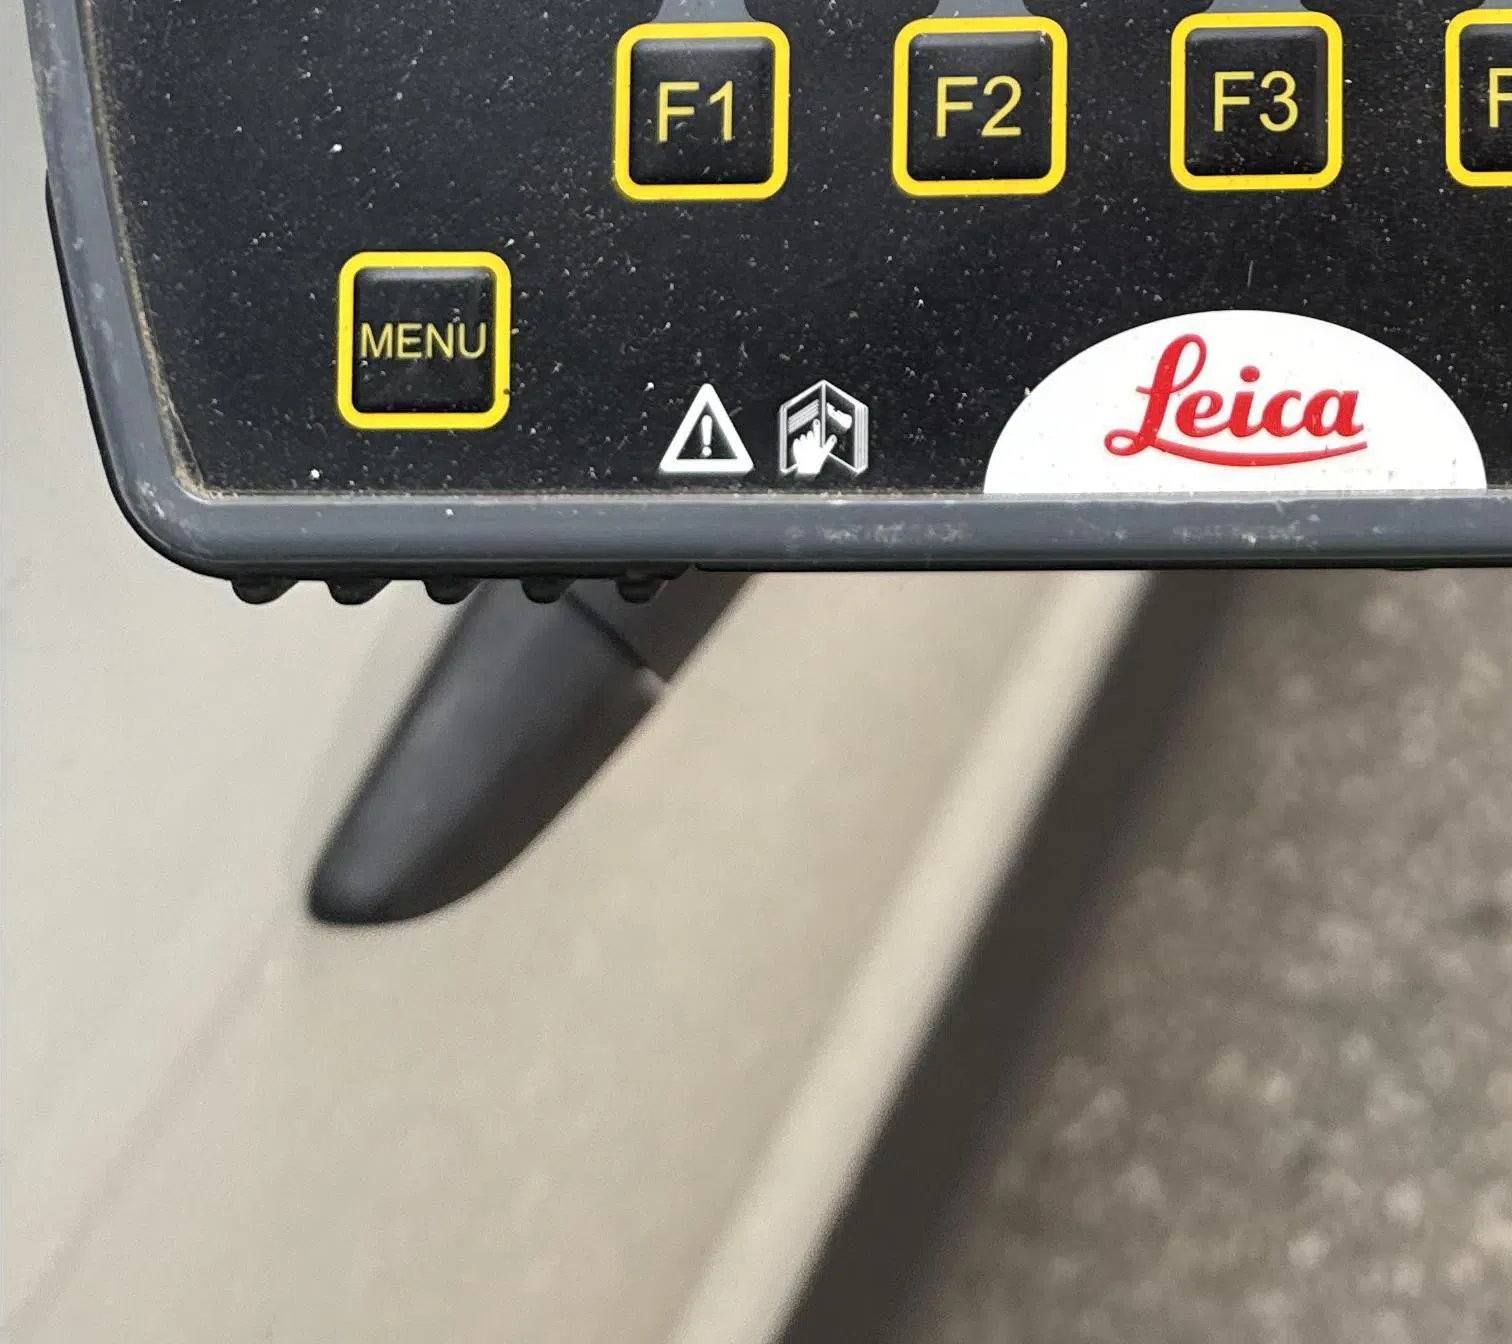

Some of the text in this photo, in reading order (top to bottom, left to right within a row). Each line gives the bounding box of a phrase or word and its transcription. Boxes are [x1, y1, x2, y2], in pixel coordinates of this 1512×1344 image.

[654, 79, 736, 144] F1
[933, 74, 1024, 140] F2
[1211, 69, 1301, 134] F3
[361, 323, 488, 359] MENU
[1105, 335, 1365, 467] Leica
